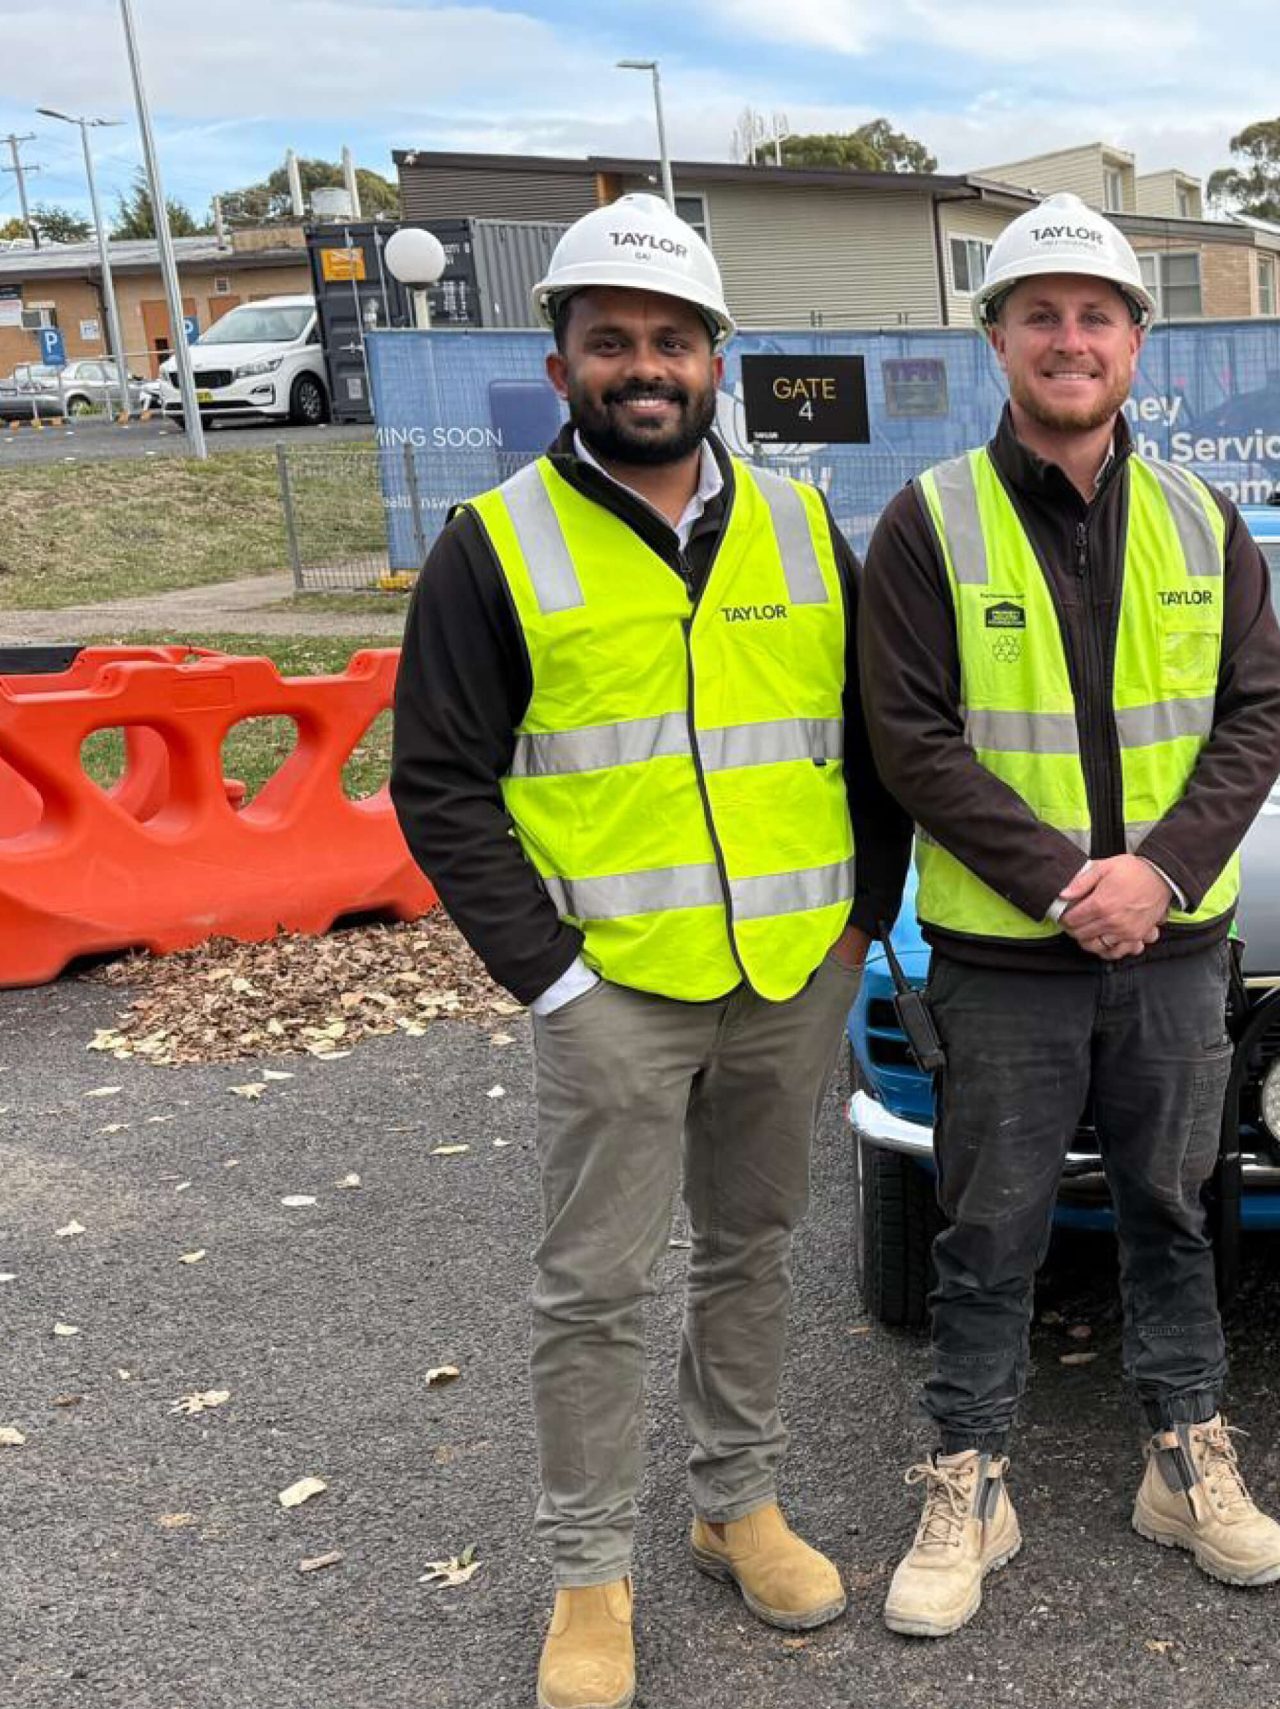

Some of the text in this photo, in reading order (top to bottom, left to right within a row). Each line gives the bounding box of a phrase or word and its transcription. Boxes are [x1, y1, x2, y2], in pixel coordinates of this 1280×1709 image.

[609, 232, 688, 258] TAYLOR
[1030, 226, 1103, 245] TAYLOR
[45, 332, 57, 352] P
[772, 378, 837, 400] GATE
[798, 400, 814, 421] 4
[1120, 396, 1182, 427] ney
[432, 427, 503, 447] SOON
[1157, 590, 1212, 605] TAYLOR
[721, 604, 788, 622] TAYLOR
